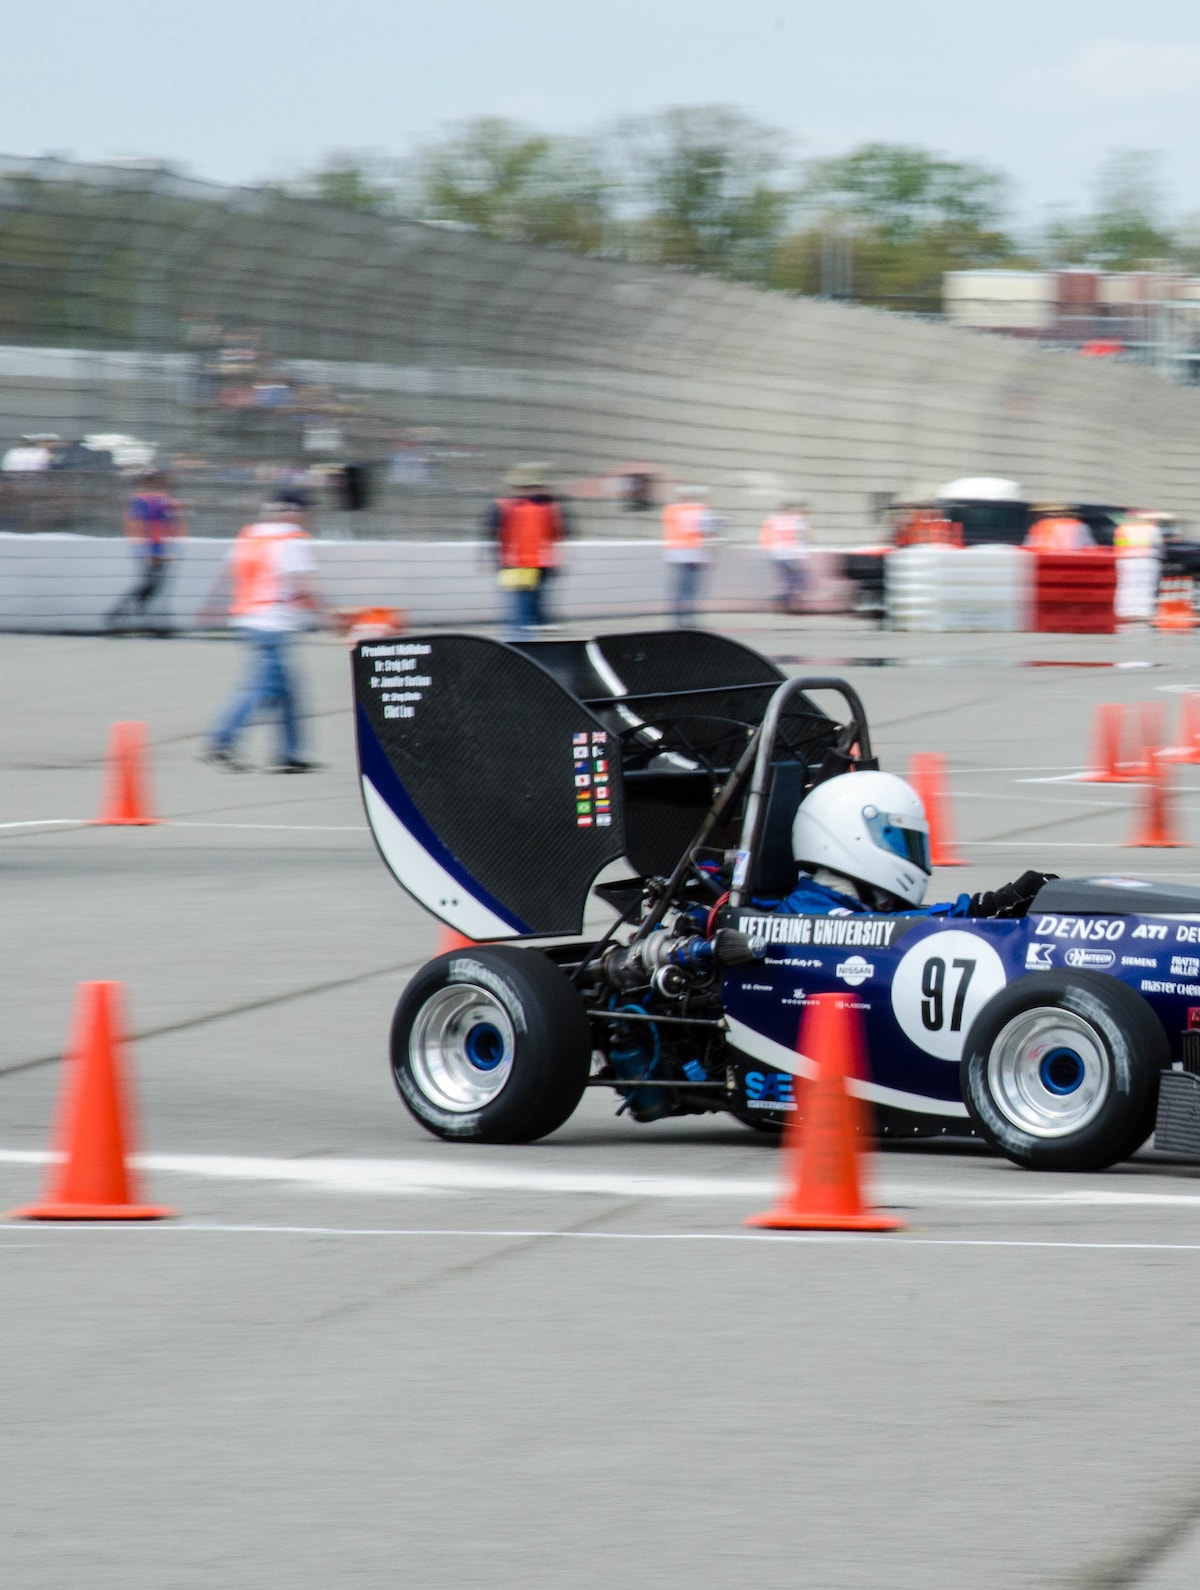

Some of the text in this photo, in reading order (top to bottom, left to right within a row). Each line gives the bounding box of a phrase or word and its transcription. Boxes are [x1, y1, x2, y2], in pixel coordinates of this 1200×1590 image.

[738, 916, 896, 946] KETTERING UNIVERSITY
[1035, 916, 1125, 941] DENSO
[1131, 924, 1169, 939] ATI
[838, 966, 872, 975] NISSAN
[1121, 956, 1157, 968] SIEMENS
[921, 957, 977, 1031] 97
[745, 1071, 796, 1102] SAE
